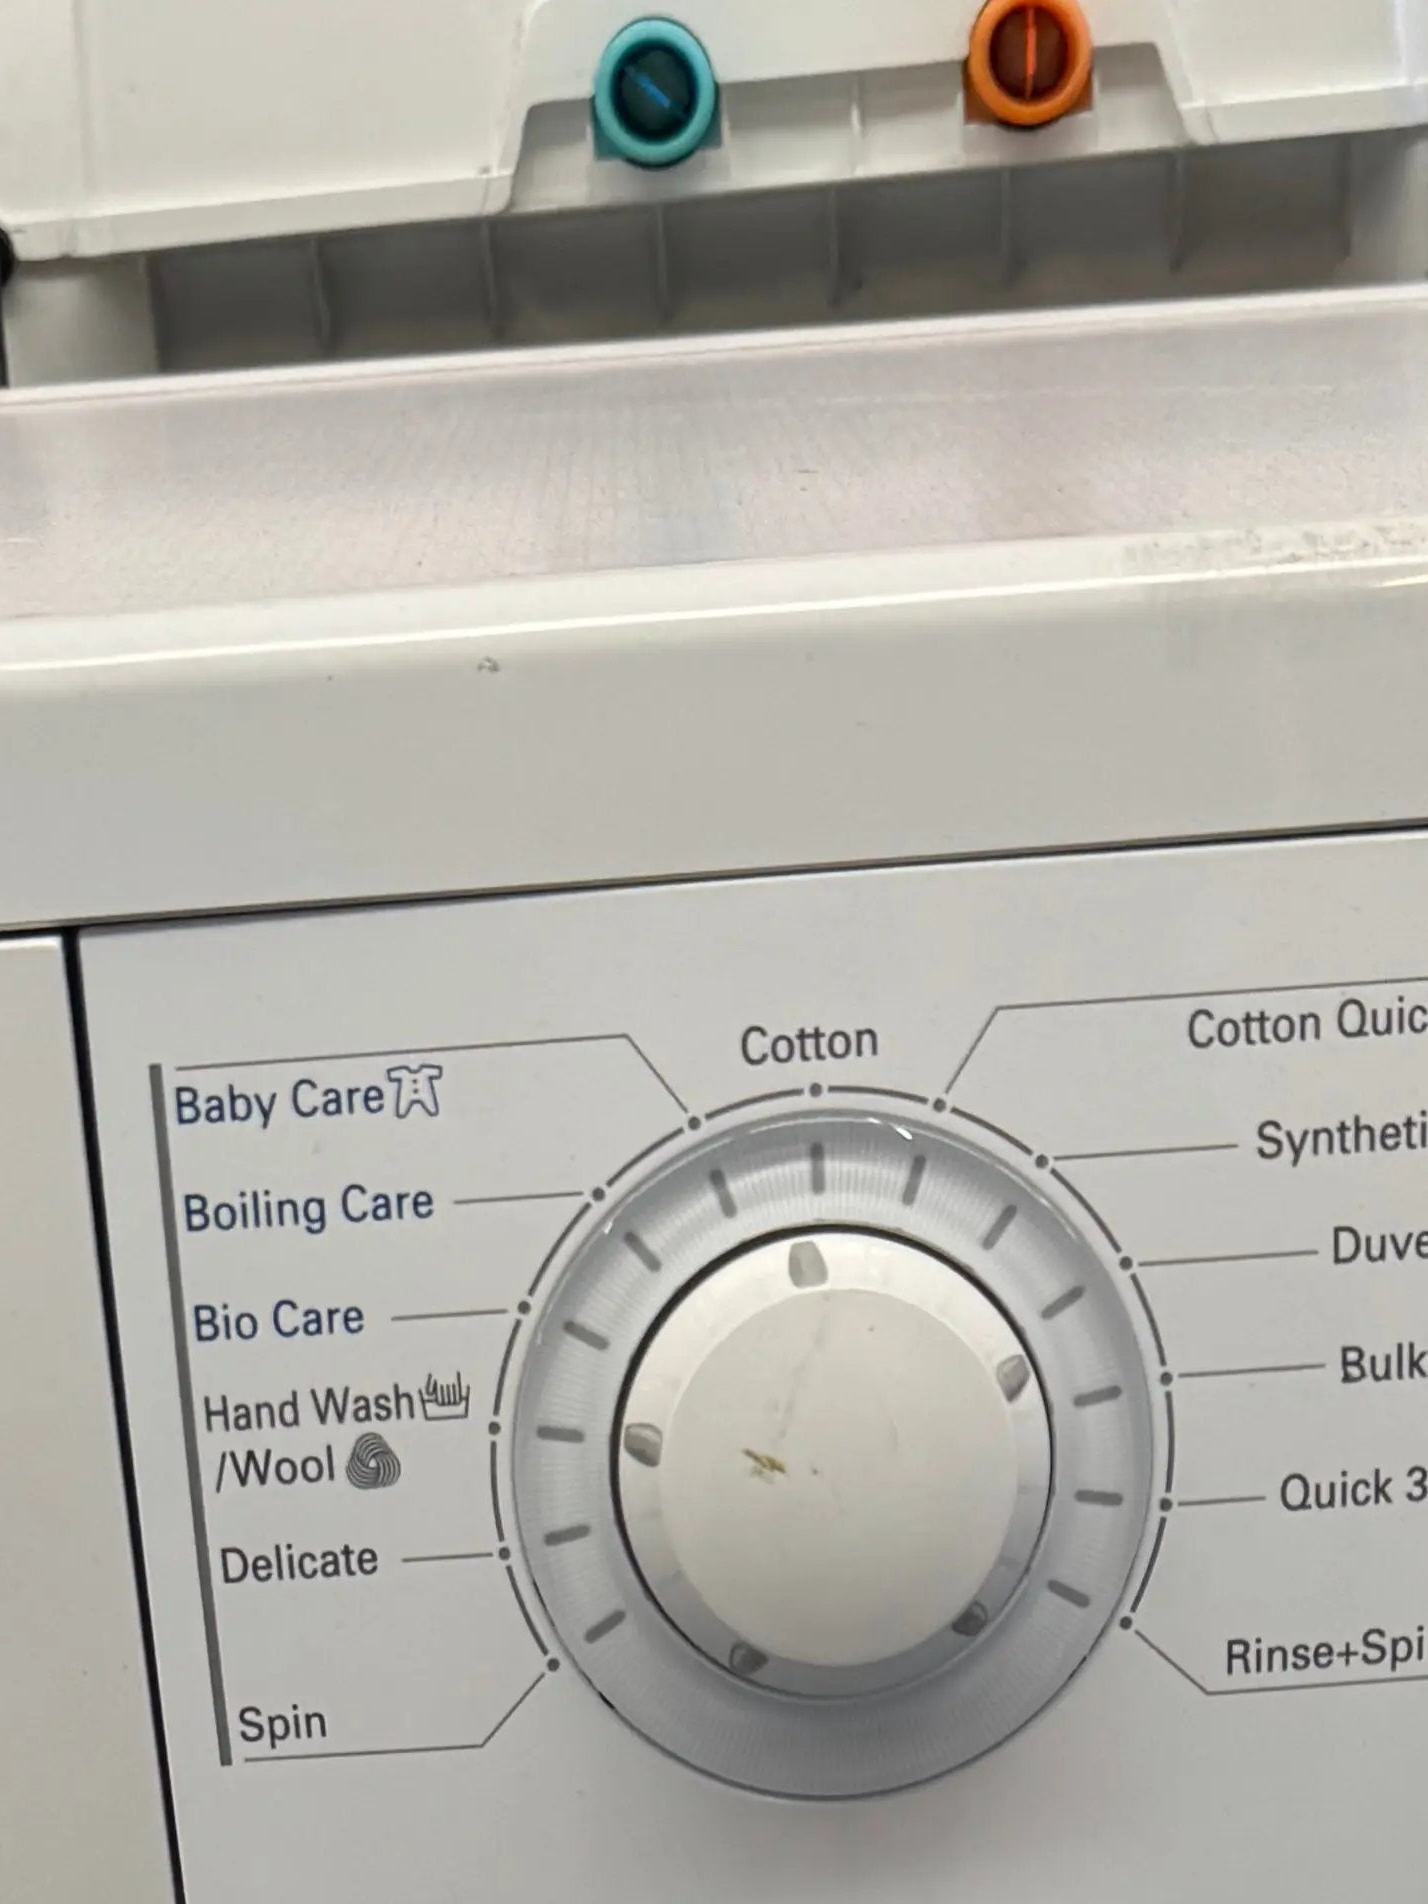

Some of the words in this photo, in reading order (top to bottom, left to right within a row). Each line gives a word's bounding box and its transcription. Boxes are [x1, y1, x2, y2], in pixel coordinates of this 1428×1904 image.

[738, 1022, 881, 1068] Cotton
[1186, 1008, 1323, 1050] Cotton
[174, 1085, 279, 1129] Baby
[290, 1077, 386, 1120] Care
[183, 1192, 329, 1237] Boiling
[340, 1182, 435, 1225] Care
[193, 1302, 260, 1344] Bio
[272, 1296, 366, 1338] Care
[204, 1391, 302, 1434] Hand
[313, 1384, 416, 1426] Wash
[214, 1444, 336, 1494] /Wool
[1279, 1464, 1394, 1516] Quick
[219, 1538, 381, 1586] Delicate
[237, 1703, 329, 1752] Spin
